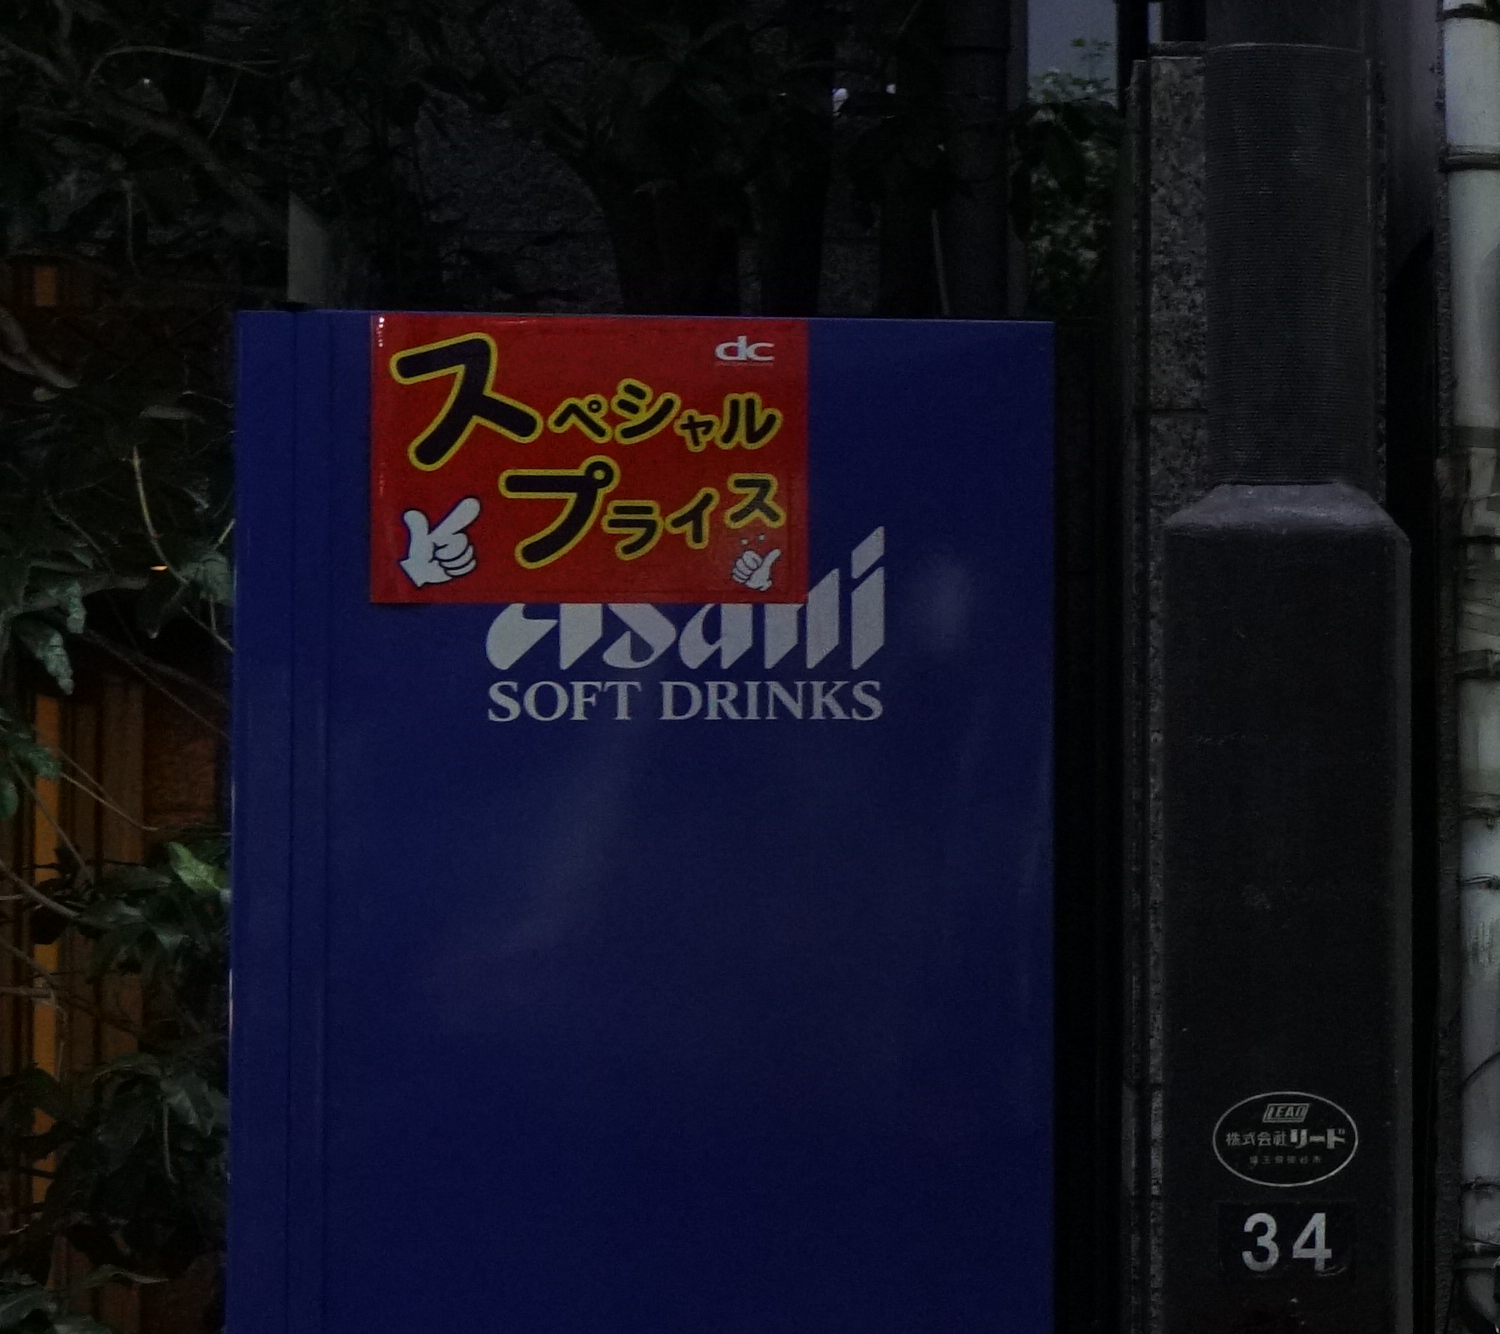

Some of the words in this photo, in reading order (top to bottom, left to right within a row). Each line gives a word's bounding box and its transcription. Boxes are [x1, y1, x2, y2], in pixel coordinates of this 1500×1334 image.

[389, 331, 784, 469] スペシャル
[499, 454, 785, 570] プライス
[486, 679, 643, 722] SOFT
[658, 679, 885, 722] DRINKS
[1267, 1104, 1308, 1119] LEAD
[1225, 1127, 1346, 1150] 株式会社リード
[1241, 1211, 1333, 1273] 34
